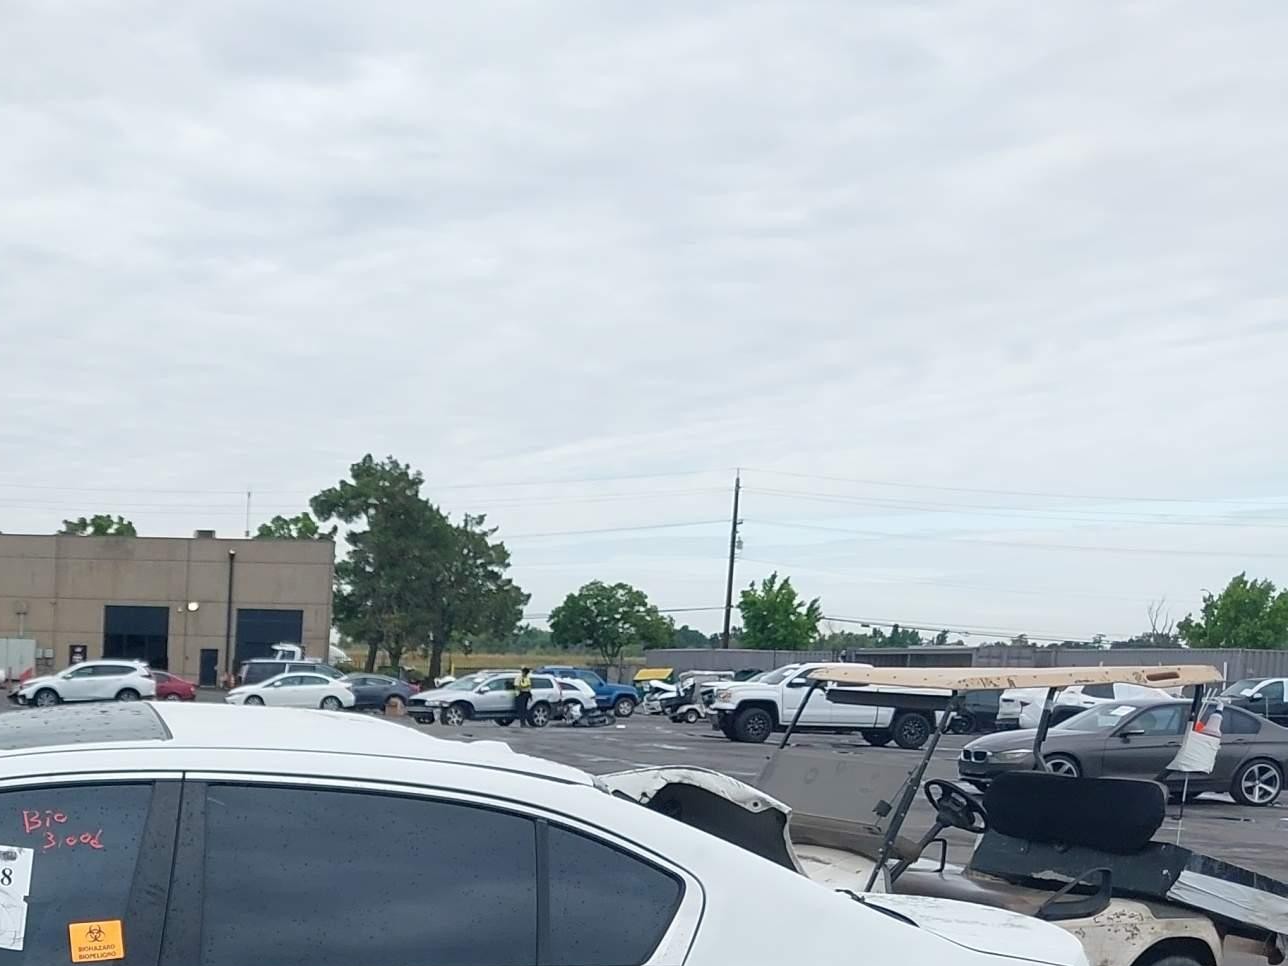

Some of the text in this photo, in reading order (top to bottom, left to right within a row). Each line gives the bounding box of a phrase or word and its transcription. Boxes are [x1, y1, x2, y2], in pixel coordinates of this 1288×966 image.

[23, 810, 67, 833] Bio
[78, 944, 116, 952] BIOHAZARD
[78, 951, 117, 960] BIOPELIGRO
